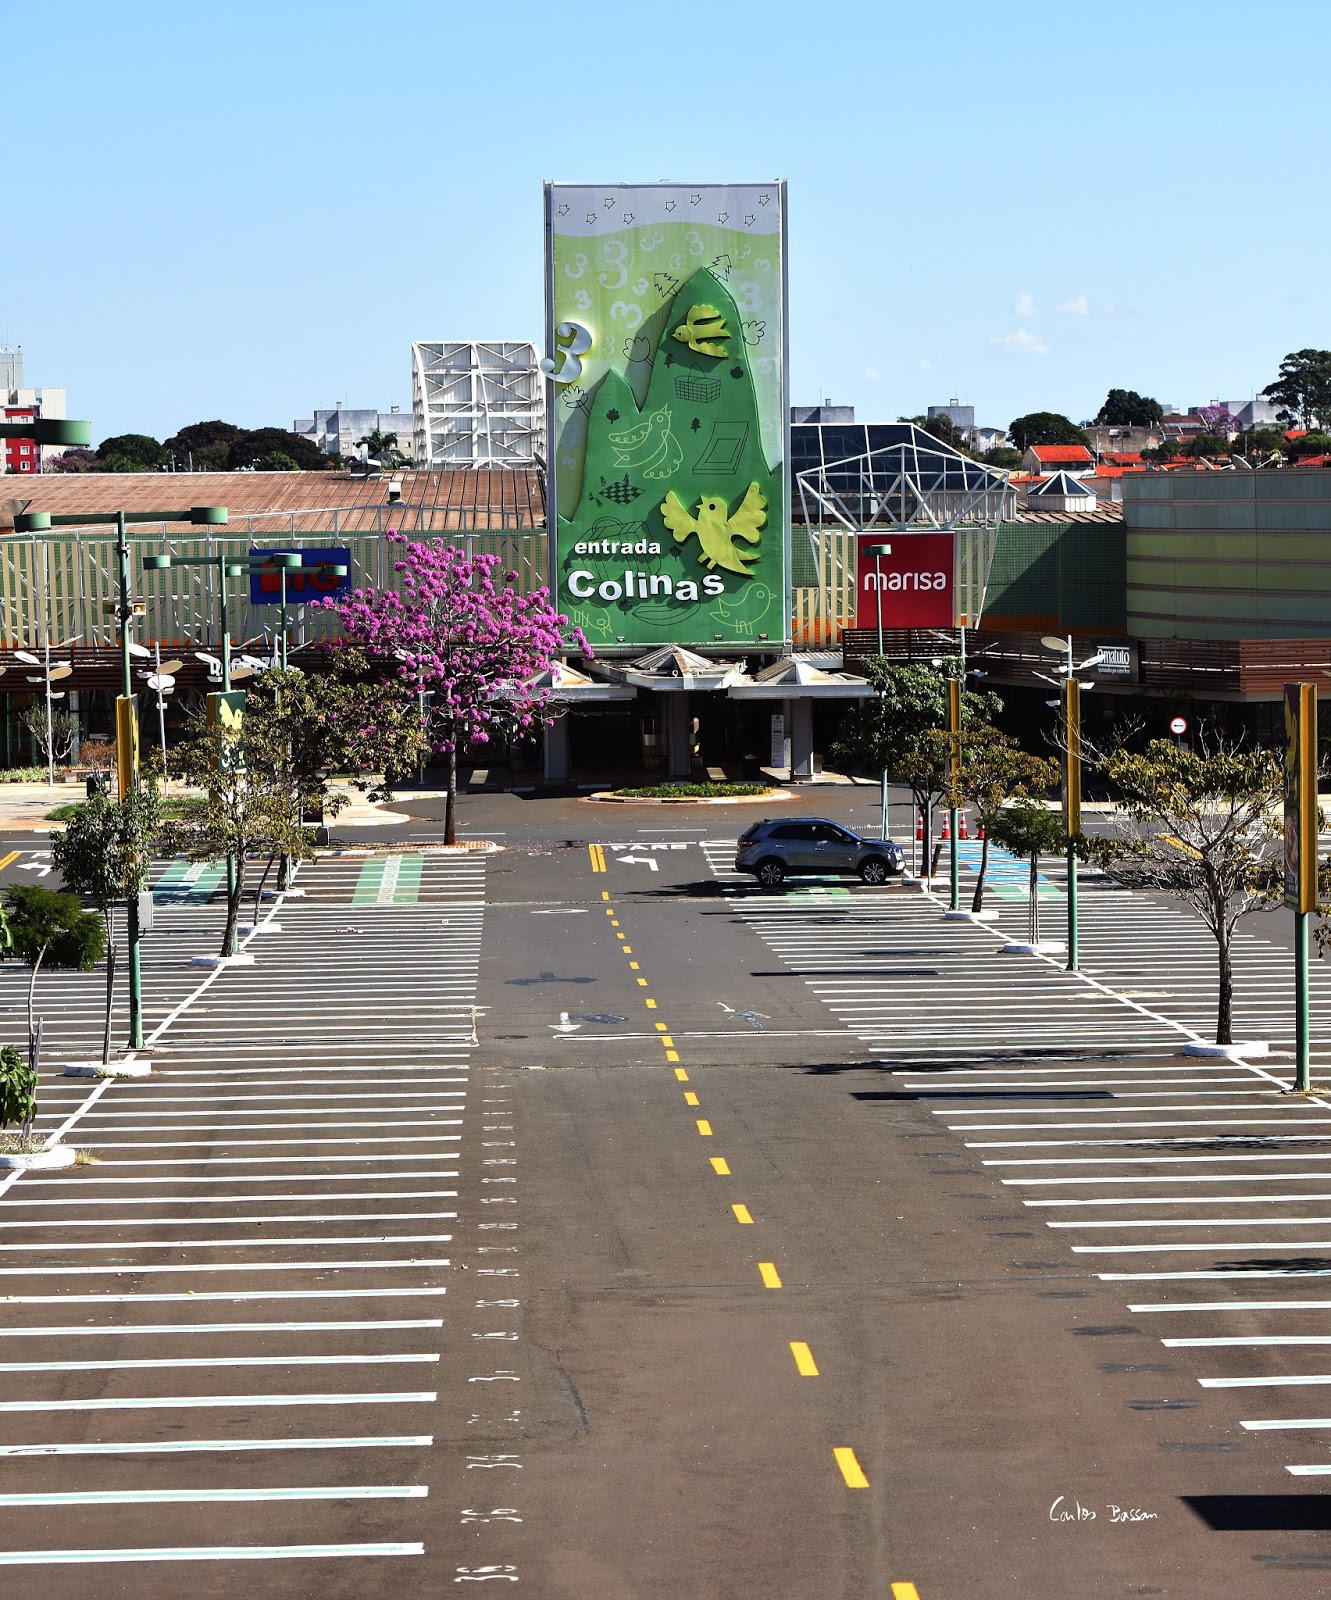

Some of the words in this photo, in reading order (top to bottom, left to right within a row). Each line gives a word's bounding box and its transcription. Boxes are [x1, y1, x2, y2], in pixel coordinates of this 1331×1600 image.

[640, 230, 664, 251] 3
[685, 231, 704, 255] 3
[564, 253, 588, 279] 3
[599, 240, 628, 289] 3
[669, 253, 680, 270] 3
[632, 278, 649, 296] 3
[739, 281, 763, 312] 3
[574, 289, 592, 311] 3
[610, 301, 643, 329] 3
[540, 322, 593, 383] 3
[602, 335, 616, 355] 3
[574, 538, 661, 555] entrada
[567, 570, 725, 601] Colinas
[864, 571, 947, 591] marisa
